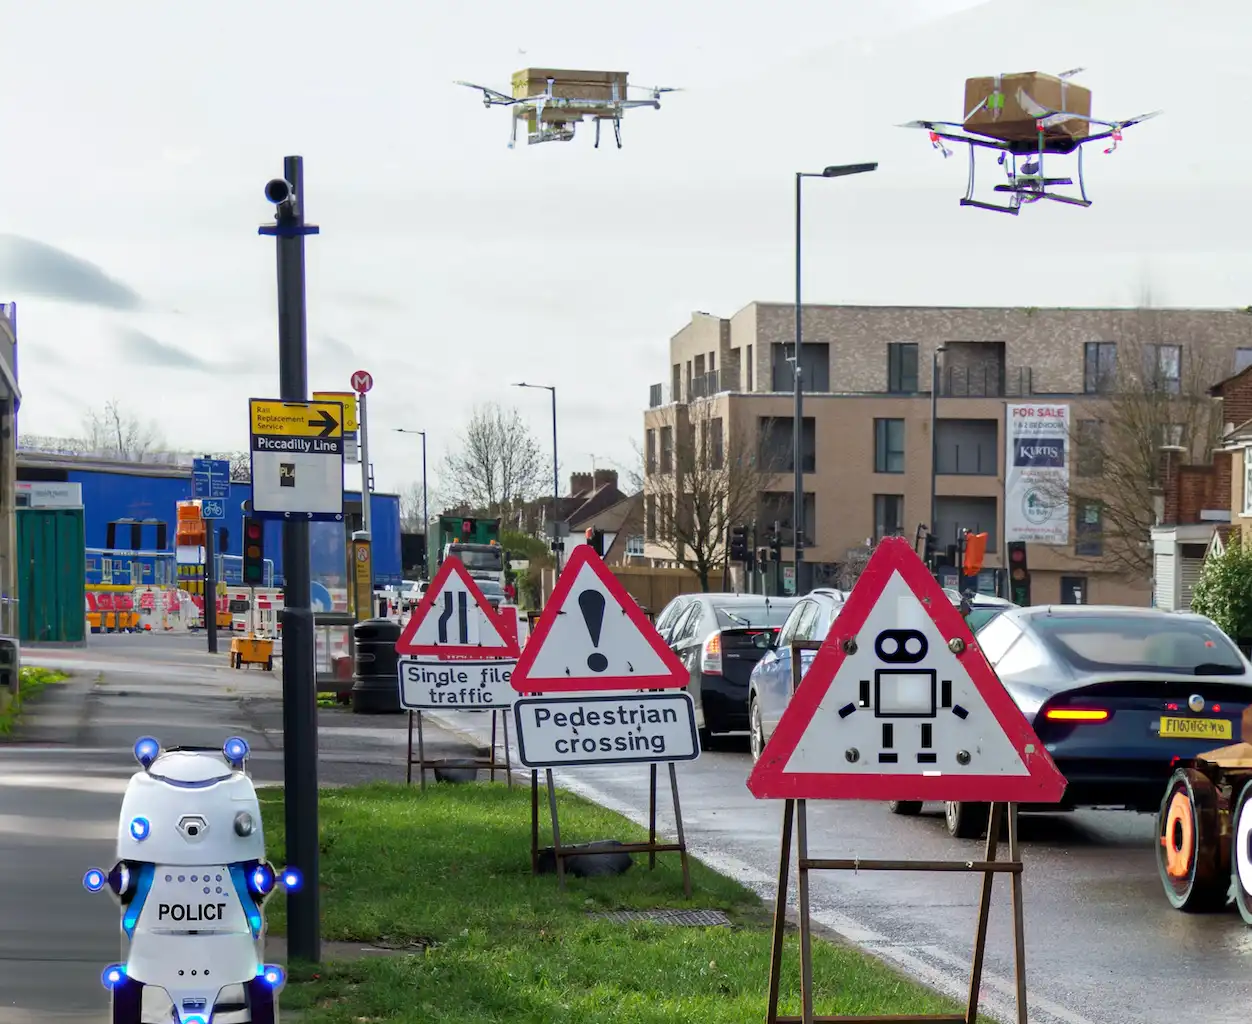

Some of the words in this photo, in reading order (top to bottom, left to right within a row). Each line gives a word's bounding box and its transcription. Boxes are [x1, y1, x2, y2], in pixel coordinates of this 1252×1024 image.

[257, 414, 304, 423] Replacement
[1012, 408, 1035, 418] FOR
[1037, 408, 1065, 418] SALE
[257, 422, 284, 430] Service
[257, 437, 312, 452] Piccadilly
[314, 441, 338, 451] Line
[280, 466, 295, 478] PL4
[407, 667, 468, 686] Single
[480, 667, 512, 683] file
[429, 688, 493, 704] traffic
[534, 704, 678, 728] Pedestrian
[554, 730, 666, 754] crossing
